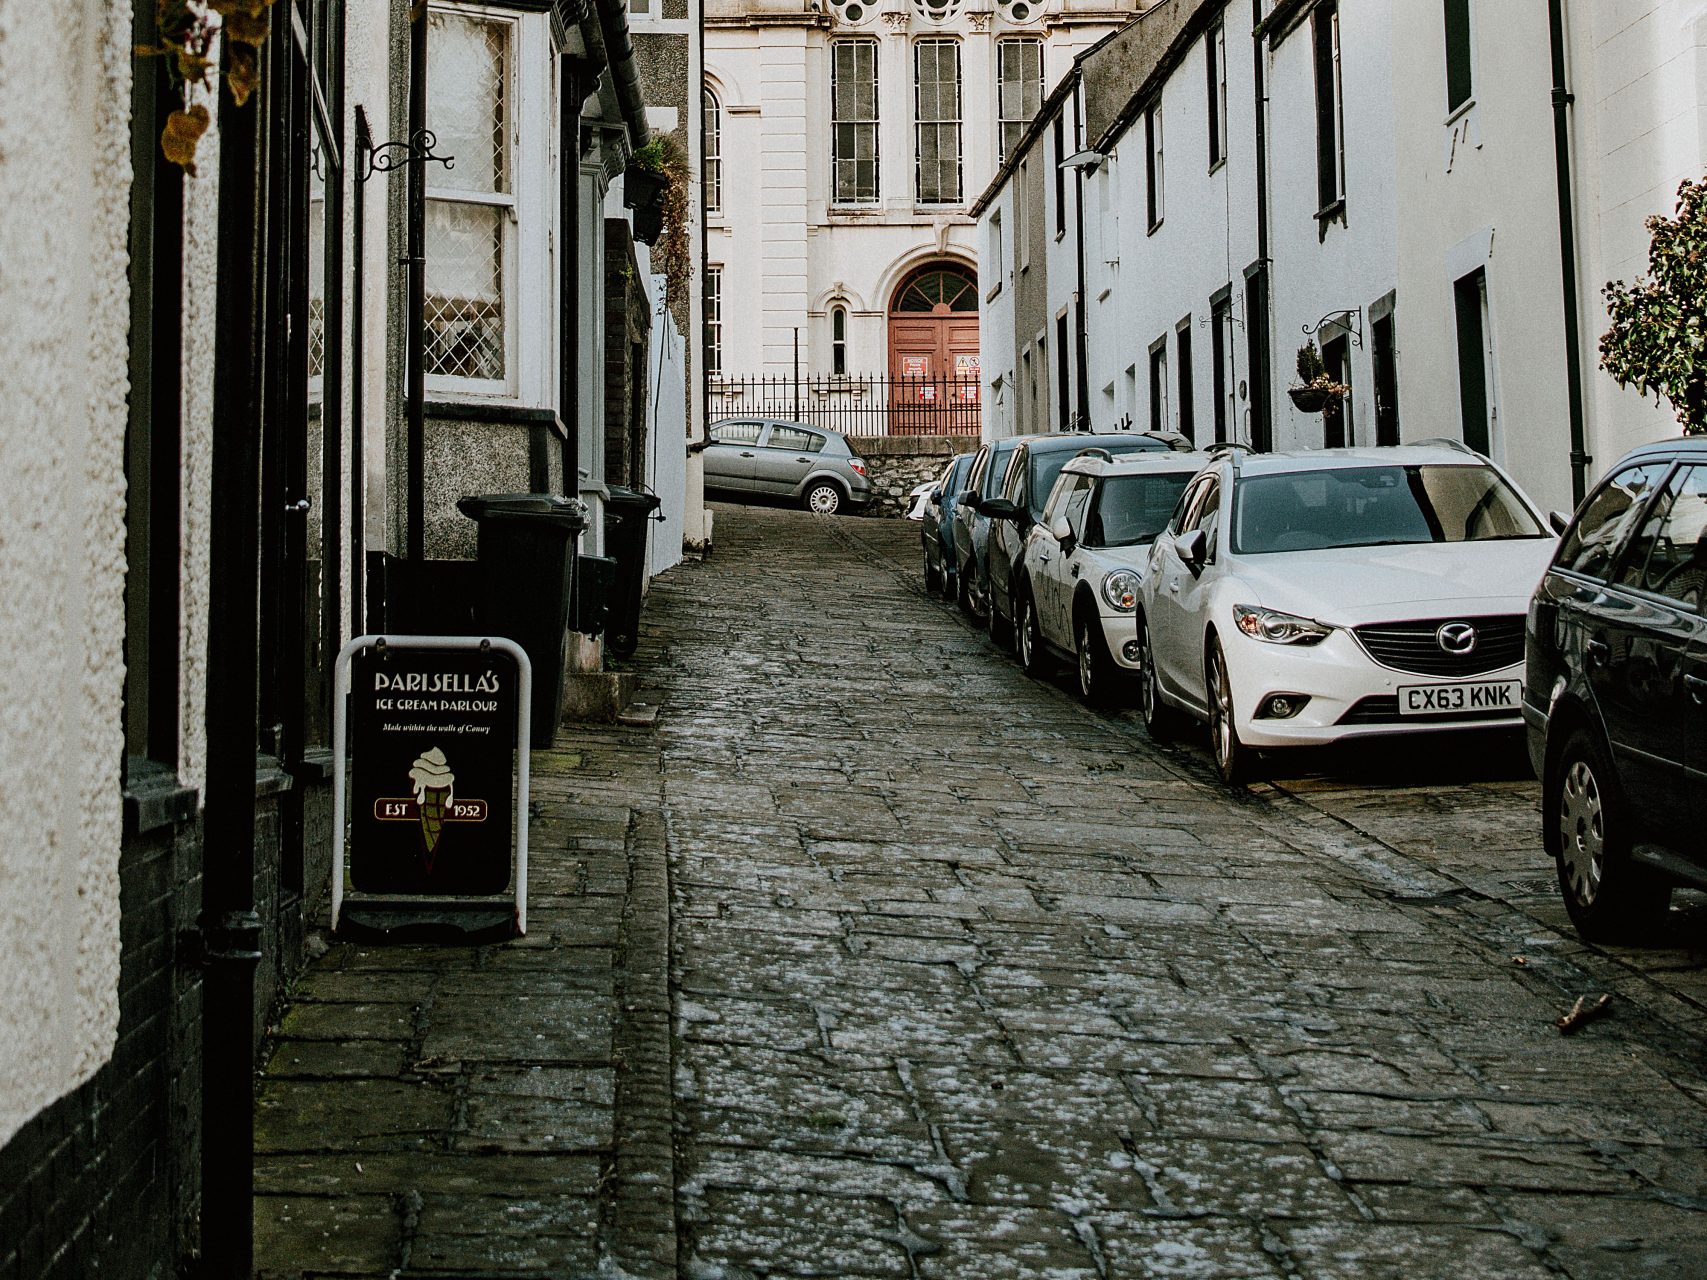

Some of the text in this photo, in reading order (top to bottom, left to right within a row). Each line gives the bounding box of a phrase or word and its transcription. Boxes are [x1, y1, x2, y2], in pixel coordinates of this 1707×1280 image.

[374, 670, 500, 693] PARISELLA'S
[1408, 685, 1511, 710] CX63 KNK
[376, 698, 498, 712] ICE CREAM PARLOUR
[382, 723, 491, 735] Made within the walls of Conwy
[385, 804, 480, 817] EST 1952
